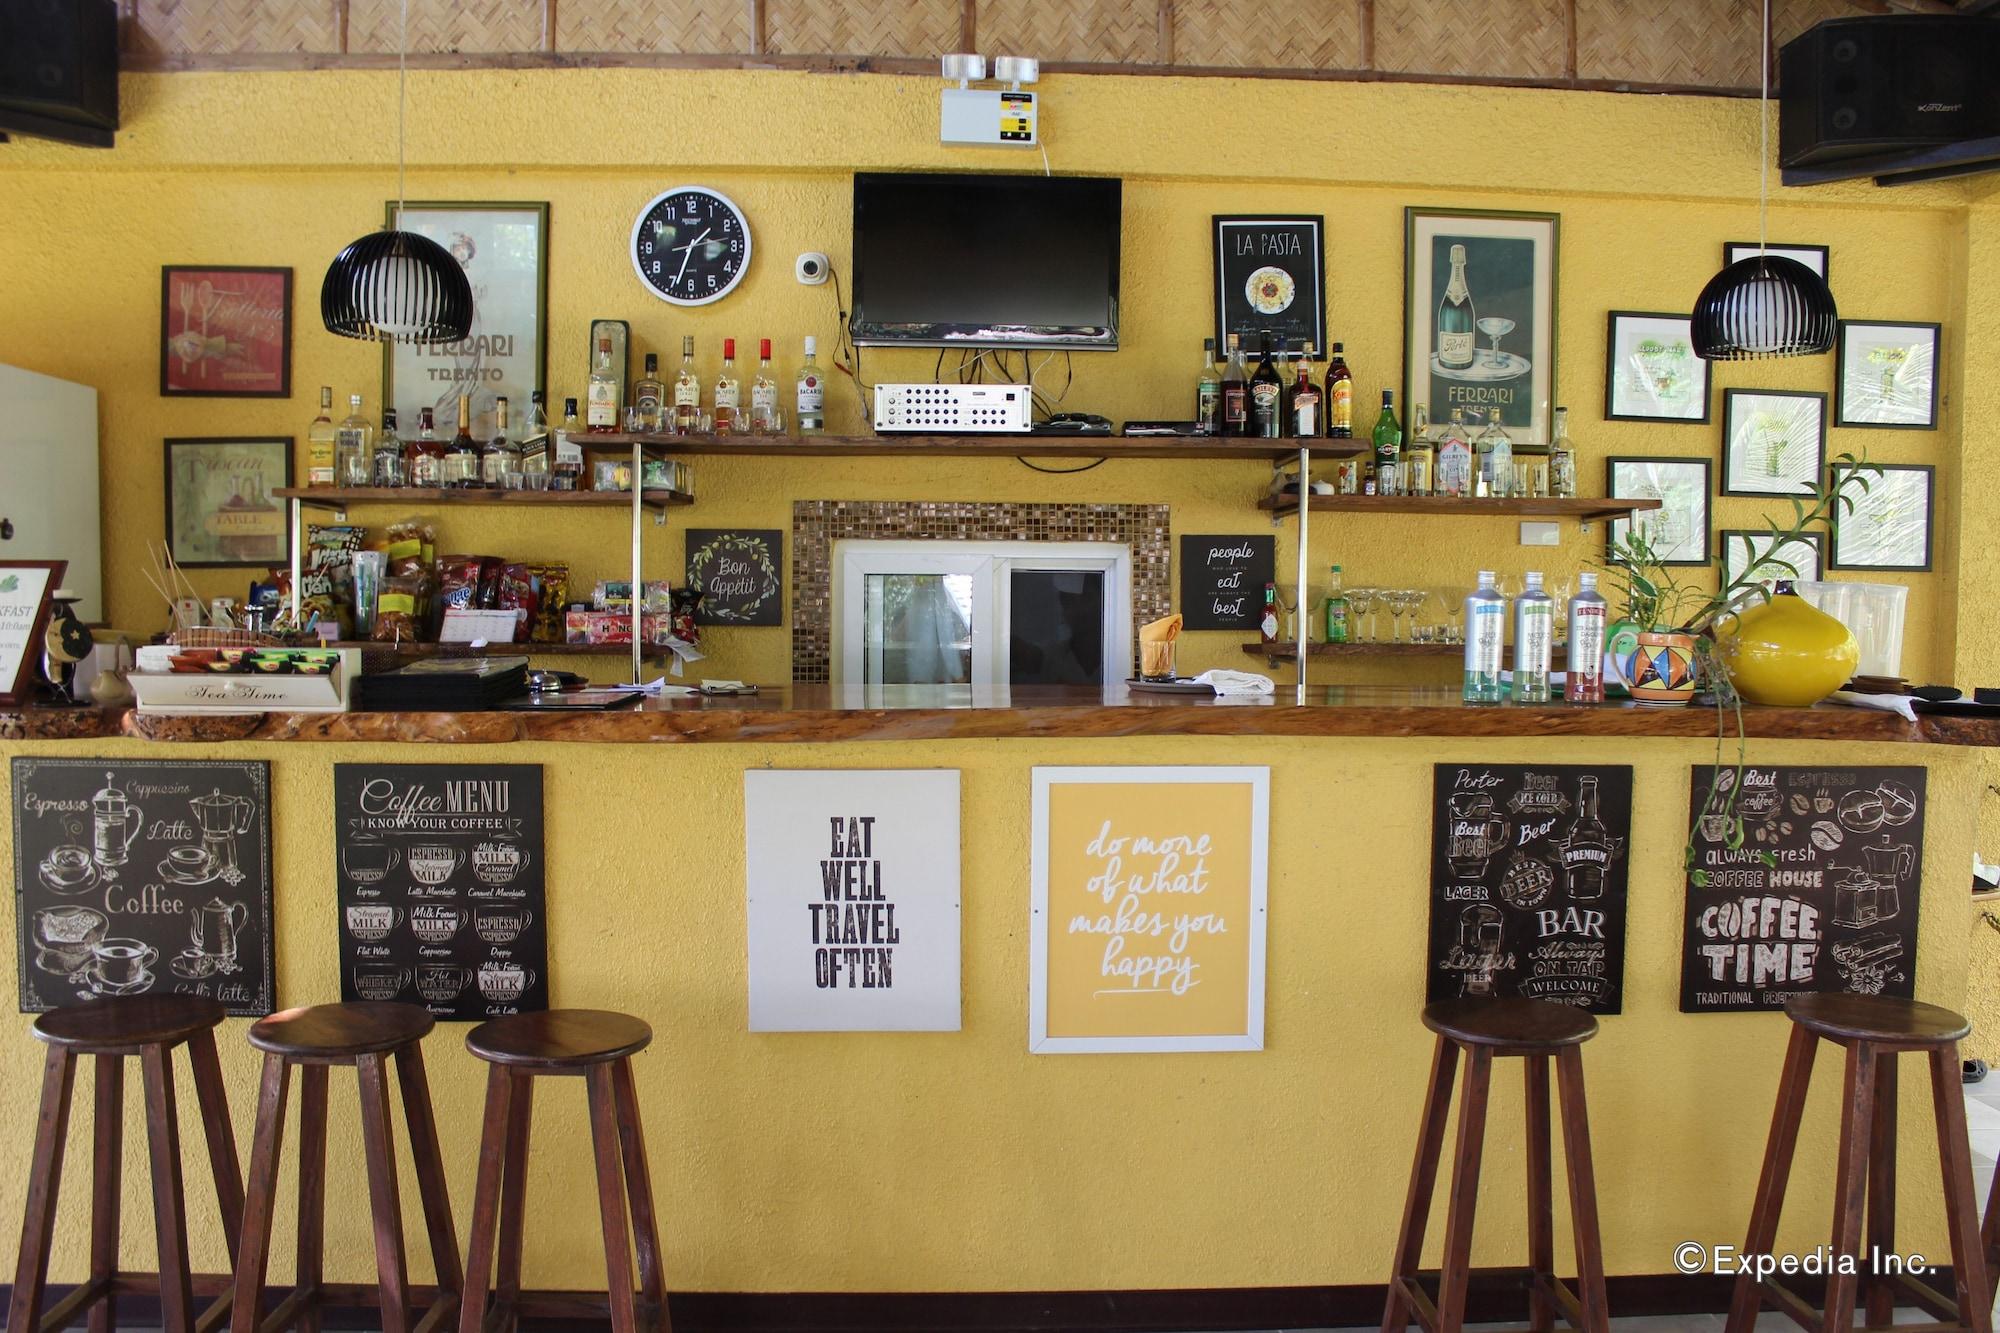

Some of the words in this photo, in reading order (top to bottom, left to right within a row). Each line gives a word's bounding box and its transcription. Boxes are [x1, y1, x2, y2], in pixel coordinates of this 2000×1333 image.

[667, 207, 676, 220] 11
[686, 201, 697, 214] 12
[708, 205, 713, 218] 1
[652, 220, 663, 234] 10
[723, 220, 731, 232] 2
[645, 242, 653, 254] 9
[730, 240, 738, 252] 3
[1236, 234, 1254, 256] LA
[1261, 233, 1301, 256] PASTA
[653, 261, 661, 273] 8
[723, 260, 732, 272] 4
[669, 275, 677, 288] 7
[687, 279, 695, 292] 6
[707, 275, 716, 287] 5
[427, 368, 503, 381] TRENTO
[1448, 386, 1513, 404] FERRARI
[1207, 541, 1254, 565] people
[718, 557, 750, 575] Bon
[1217, 572, 1243, 588] eat
[710, 577, 757, 600] Appétit
[1213, 598, 1245, 617] best
[186, 685, 227, 699] Tea
[231, 685, 288, 699] Time
[1454, 768, 1504, 789] Porter
[1744, 769, 1776, 786] Best
[24, 793, 89, 818] Espresso
[360, 778, 443, 824] Coffee
[446, 781, 509, 813] MENU
[1744, 793, 1774, 810] coffee
[147, 820, 193, 840] Latte
[412, 818, 447, 829] YOUR
[451, 818, 503, 829] COFFEE
[1455, 821, 1486, 836] Best
[830, 816, 875, 858] EAT
[1086, 820, 1129, 857] do
[1132, 832, 1212, 857] more
[1518, 818, 1556, 846] Beer
[478, 853, 513, 864] MILK
[1565, 849, 1607, 863] PREMIUM
[820, 860, 886, 901] WELL
[1086, 863, 1124, 903] of
[1128, 853, 1208, 894] what
[1769, 870, 1823, 888] HOUSE
[105, 884, 184, 914] Coffee
[1445, 886, 1490, 900] LAGER
[413, 907, 434, 919] Milk
[1701, 897, 1819, 939] COFFEE
[353, 918, 387, 929] MILK
[416, 920, 451, 930] MILK
[478, 918, 519, 930] ESPRESSO
[808, 903, 900, 945] TRAVEL
[1069, 895, 1170, 937] makes
[1172, 914, 1227, 955] you
[1535, 906, 1607, 939] BAR
[1528, 941, 1606, 966] Always
[815, 947, 893, 988] OFTEN
[1102, 937, 1201, 995] happy
[1534, 961, 1562, 977] ON
[1567, 961, 1606, 977] TAP
[1702, 943, 1817, 984] TIME
[484, 980, 518, 990] MILK
[1531, 980, 1600, 993] WELCOME
[1696, 992, 1754, 1004] TRADITIONAL
